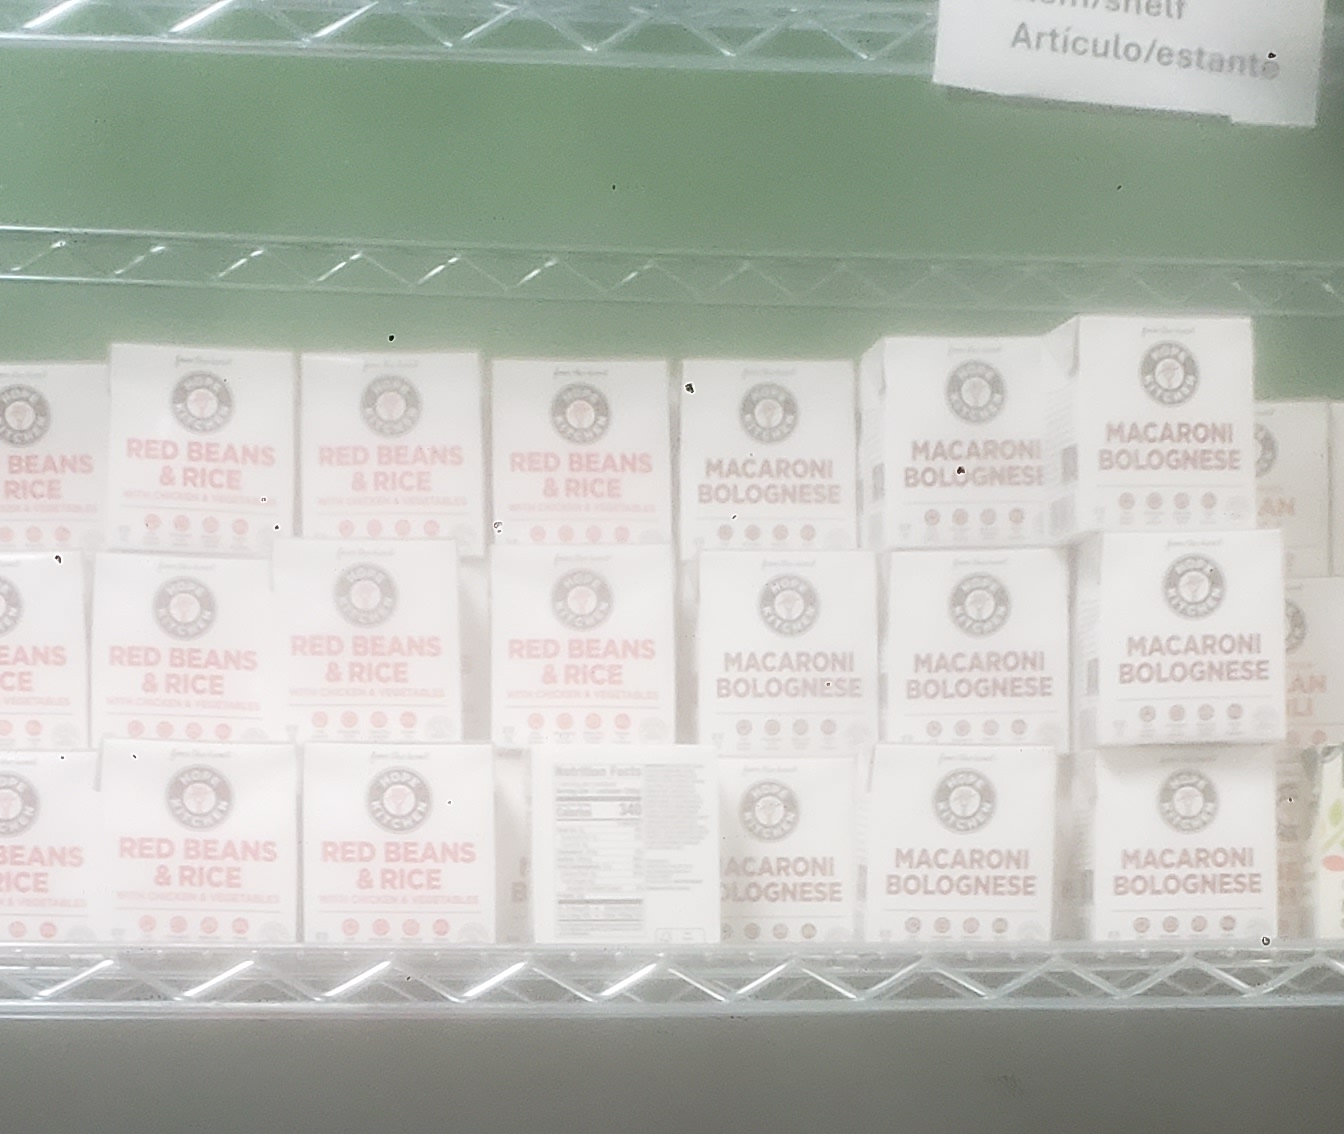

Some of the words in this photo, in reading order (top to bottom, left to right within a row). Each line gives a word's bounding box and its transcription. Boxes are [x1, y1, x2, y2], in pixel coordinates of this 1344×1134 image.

[1011, 22, 1281, 80] Artículo/estante
[1105, 421, 1233, 445] MACARONI
[126, 438, 179, 461] RED
[187, 441, 276, 466] BEANS
[318, 446, 370, 466] RED
[376, 445, 464, 466] BEANS
[911, 439, 1042, 461] MACARONI
[1098, 448, 1241, 471] BOLOGNESE
[8, 454, 94, 475] BEANS
[509, 452, 561, 473] RED
[568, 452, 653, 474] BEANS
[705, 459, 833, 479] MACARONI
[4, 480, 62, 500] RICE
[182, 469, 243, 490] RICE
[373, 471, 432, 492] RICE
[565, 478, 622, 499] RICE
[698, 484, 840, 504] BOLOGNESE
[291, 635, 344, 656] RED
[352, 635, 442, 657] BEANS
[507, 639, 560, 660] RED
[567, 639, 656, 660] BEANS
[1127, 632, 1262, 657] MACARONI
[108, 645, 161, 668] RED
[169, 648, 258, 671] BEANS
[724, 651, 854, 673] MACARONI
[914, 651, 1045, 673] MACARONI
[349, 662, 409, 683] RICE
[565, 664, 624, 685] RICE
[1118, 659, 1270, 685] BOLOGNESE
[165, 673, 224, 695] RICE
[716, 677, 862, 699] BOLOGNESE
[906, 676, 1053, 699] BOLOGNESE
[119, 837, 175, 859] RED
[183, 838, 278, 862] BEANS
[321, 841, 376, 862] RED
[384, 841, 476, 863] BEANS
[895, 848, 1029, 870] MACARONI
[1121, 847, 1254, 869] MACARONI
[178, 865, 242, 889] RICE
[380, 869, 443, 891] RICE
[886, 874, 1036, 896] BOLOGNESE
[1113, 872, 1262, 895] BOLOGNESE
